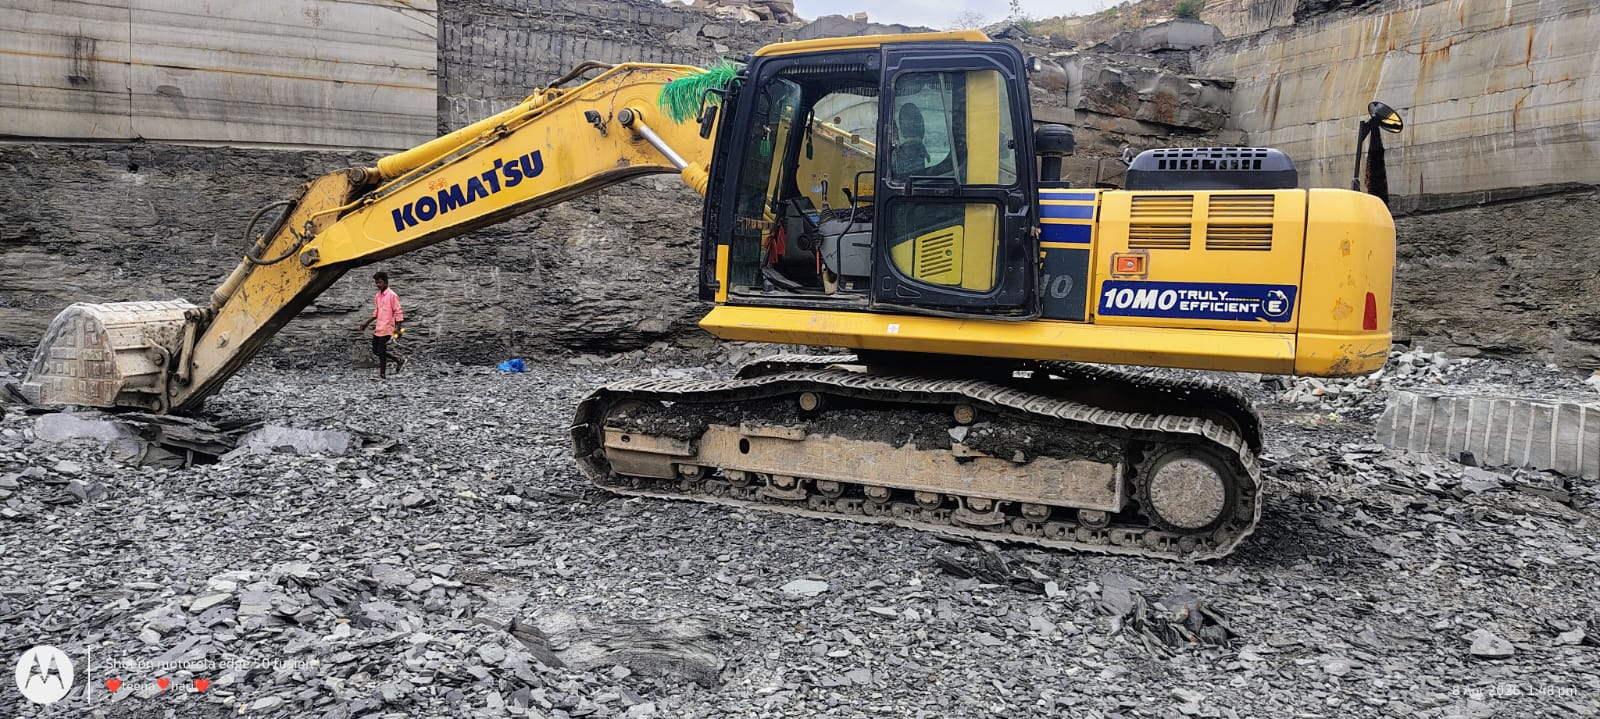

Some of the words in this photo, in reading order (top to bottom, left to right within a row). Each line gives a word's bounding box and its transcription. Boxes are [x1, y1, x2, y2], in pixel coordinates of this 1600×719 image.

[391, 150, 544, 232] KOMATSU
[1179, 301, 1260, 313] EFFICIENT
[1268, 300, 1282, 313] E
